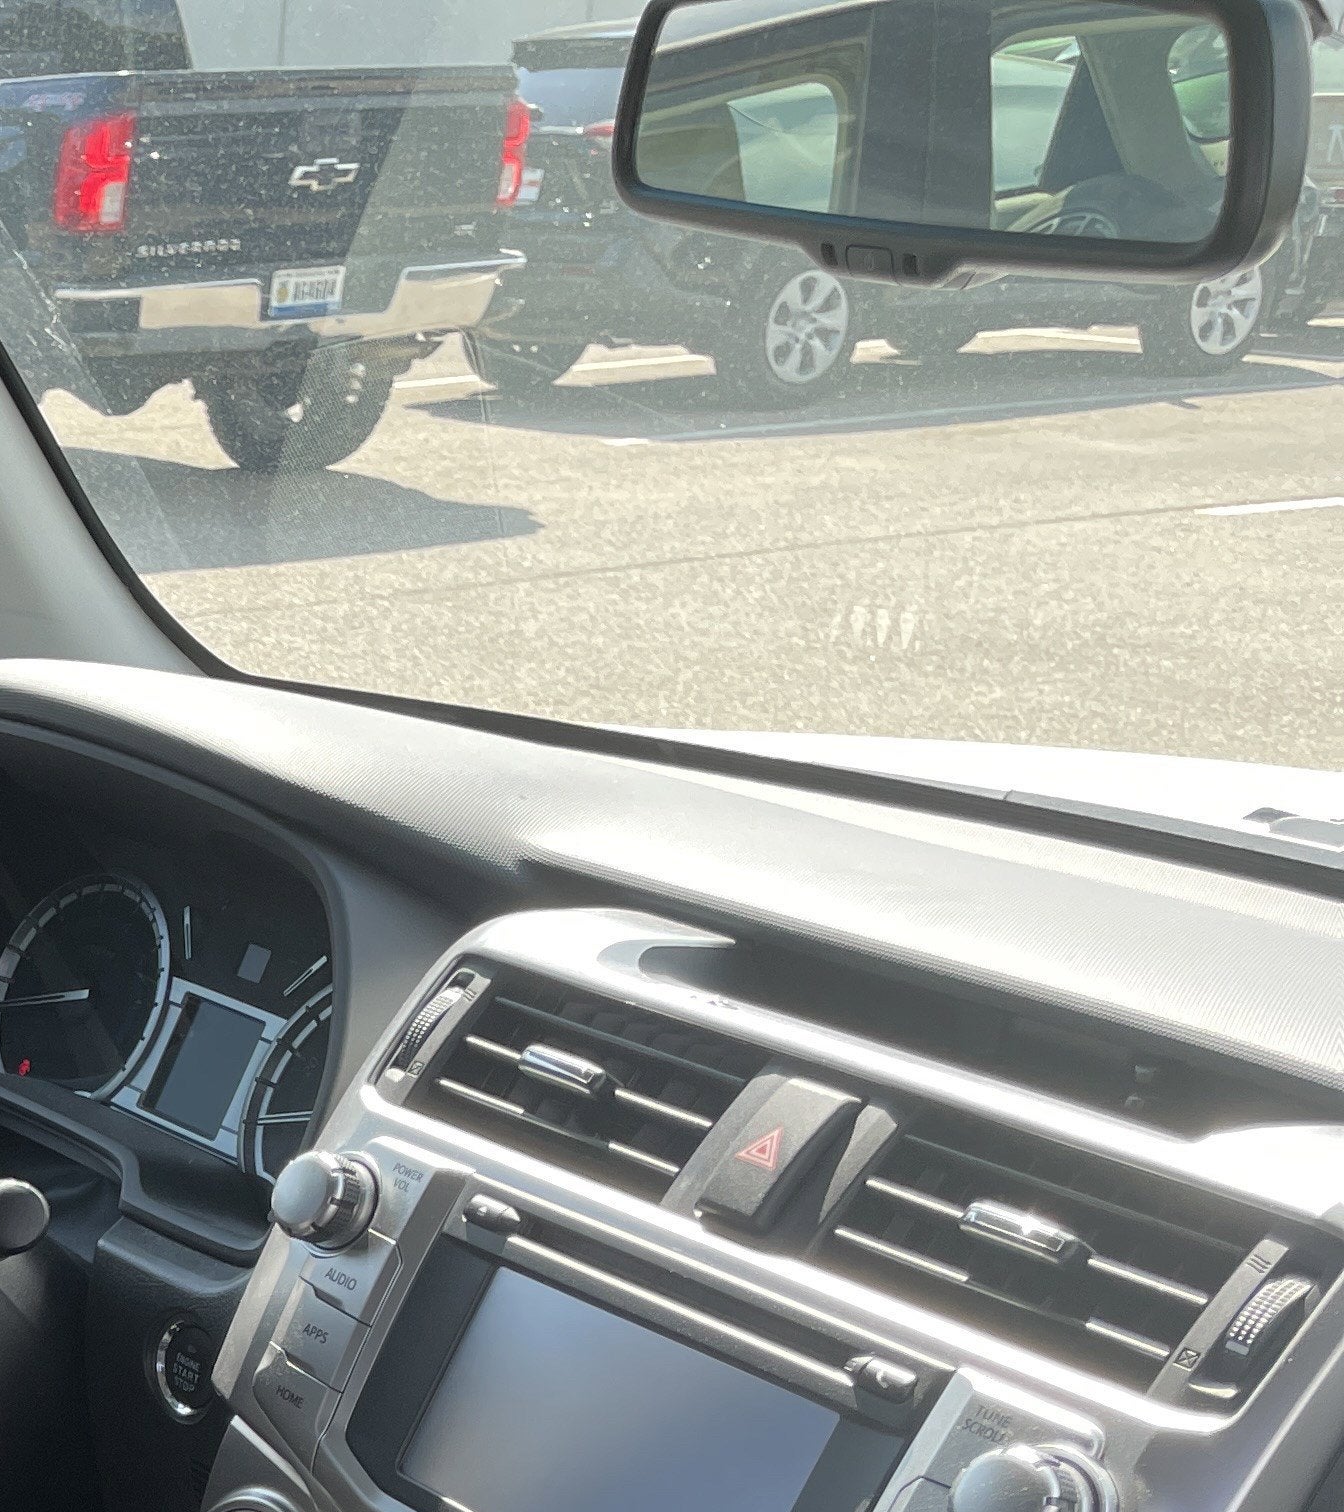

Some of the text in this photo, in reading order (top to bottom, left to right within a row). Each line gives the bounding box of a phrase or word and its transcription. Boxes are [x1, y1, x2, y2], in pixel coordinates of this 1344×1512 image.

[392, 1163, 424, 1182] POWER
[393, 1180, 410, 1192] VOL
[324, 1267, 358, 1291] AUDIO
[302, 1323, 329, 1344] APPS
[275, 1384, 304, 1410] HOME
